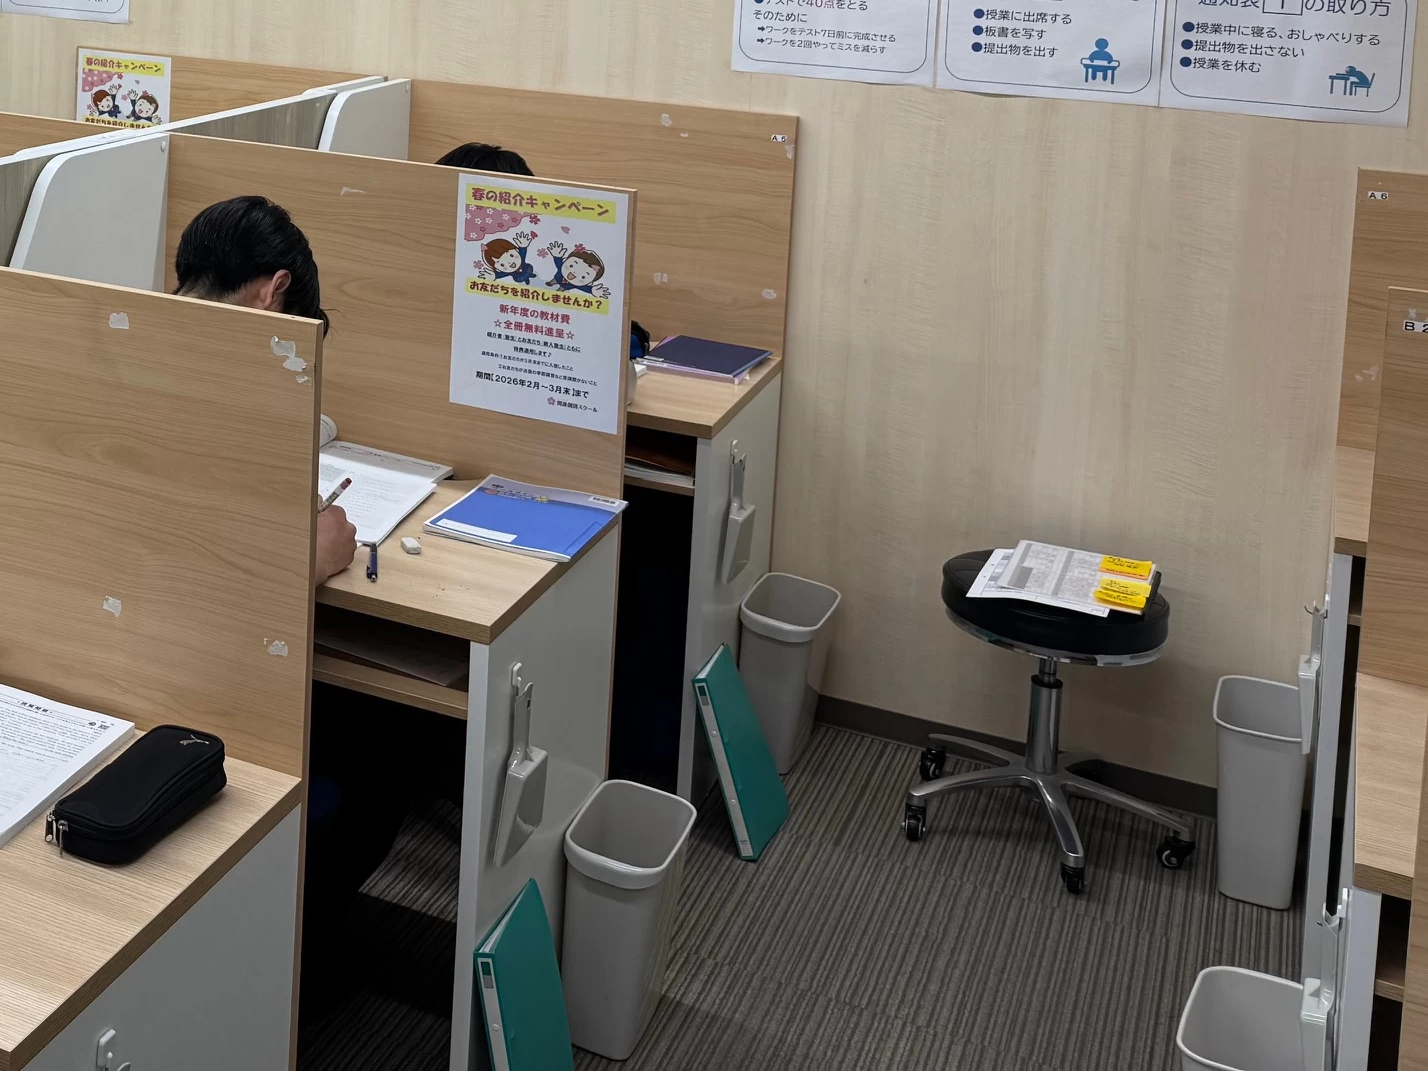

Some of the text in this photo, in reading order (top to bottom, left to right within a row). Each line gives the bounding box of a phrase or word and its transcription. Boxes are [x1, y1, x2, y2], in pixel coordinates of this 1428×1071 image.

[753, 10, 808, 22] そのために
[986, 9, 1072, 25] 授業に出席する
[766, 26, 896, 42] ワークをテスト7日前に完成させる
[984, 25, 1046, 40] 板書を写す
[1196, 22, 1381, 46] 授業中に寝る、おしゃべりする
[765, 37, 886, 54] ワークを2回やってミスを減らす
[983, 42, 1058, 58] 提出物を出す
[1194, 40, 1305, 58] 提出物を出さない
[86, 57, 161, 73] 春の紹介キャンペーン
[1192, 57, 1262, 73] 授業を休む
[472, 187, 610, 217] 春の紹介キャンペーン
[470, 281, 603, 310] お友だちを紹介しませんか？
[499, 304, 571, 324] 新年度の教材費
[1404, 322, 1415, 331] B
